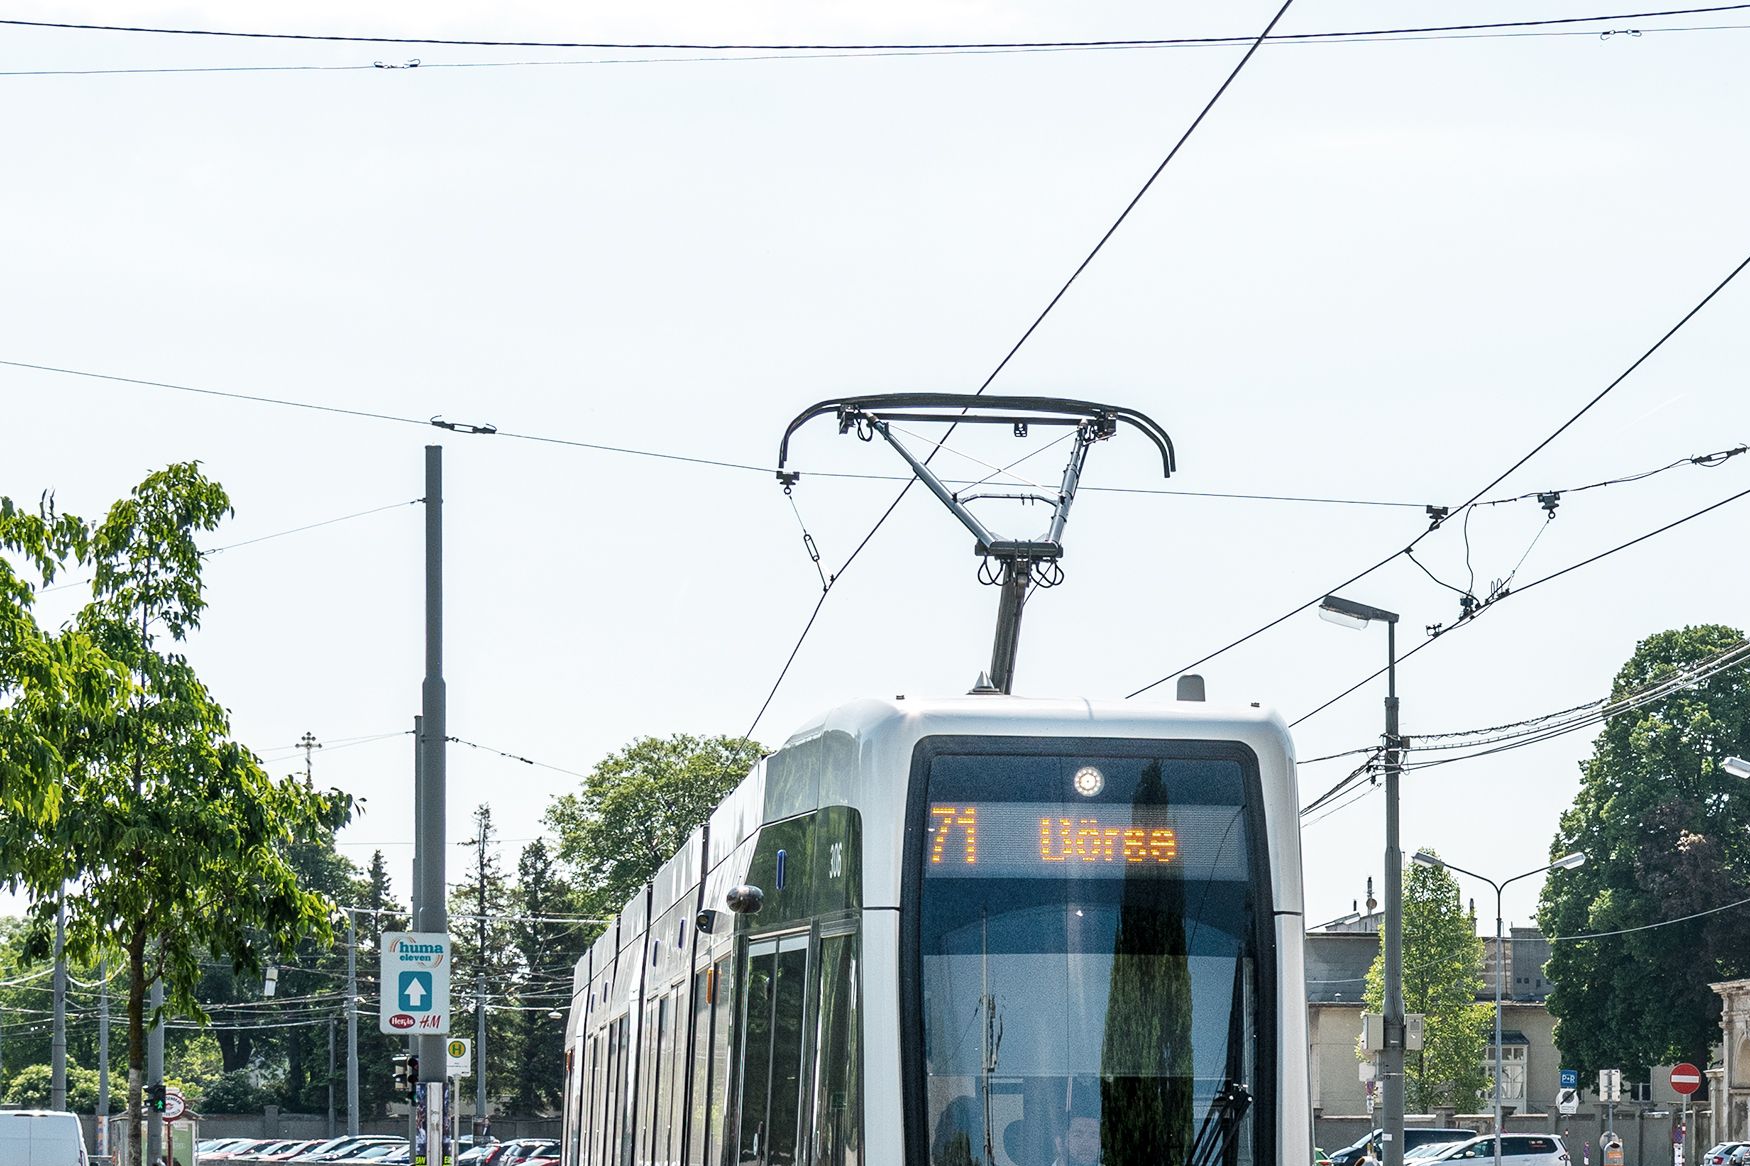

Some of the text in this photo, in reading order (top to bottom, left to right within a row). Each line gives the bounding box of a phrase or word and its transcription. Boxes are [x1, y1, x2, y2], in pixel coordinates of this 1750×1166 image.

[931, 807, 1175, 863] 71 Börse
[829, 841, 843, 880] 306
[399, 941, 444, 954] huma
[399, 954, 431, 962] eleven
